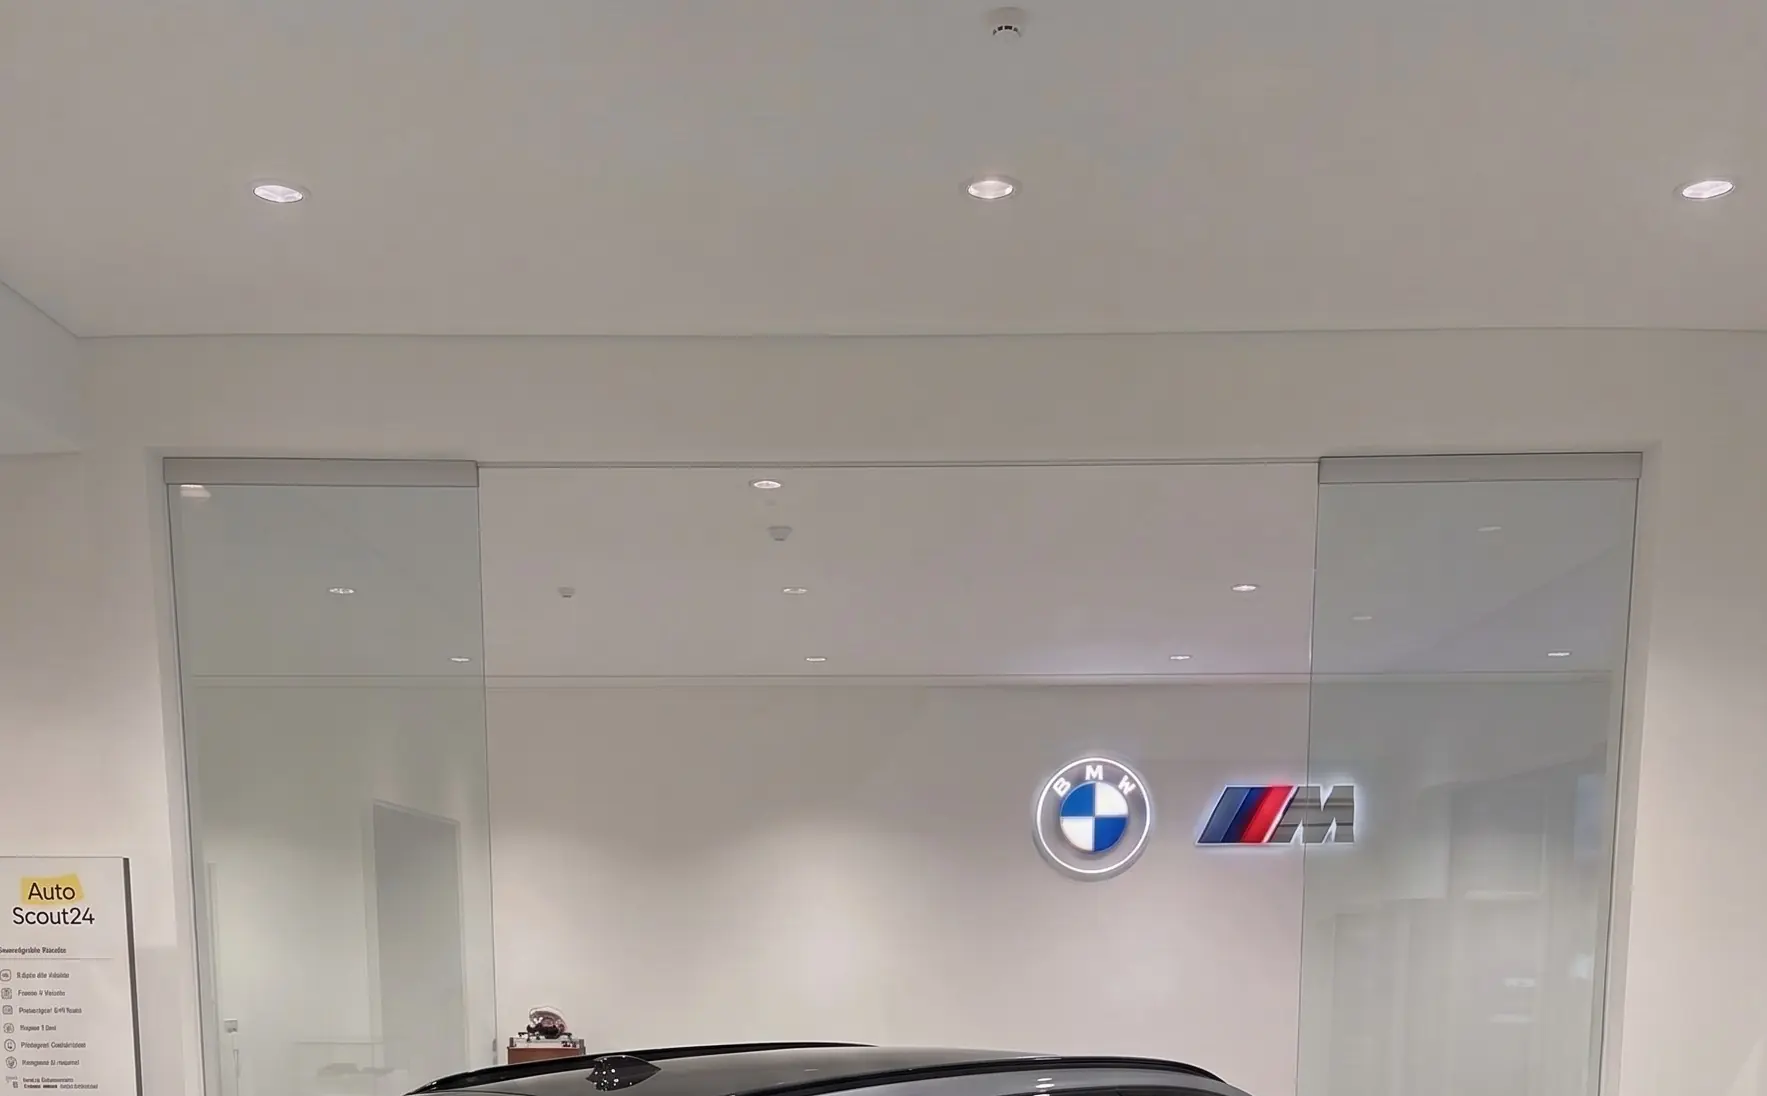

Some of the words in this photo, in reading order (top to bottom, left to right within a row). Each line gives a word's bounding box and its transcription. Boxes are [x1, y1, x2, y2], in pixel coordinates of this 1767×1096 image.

[1052, 764, 1137, 798] BMW
[1262, 784, 1356, 845] M
[27, 881, 76, 901] Auto
[12, 906, 95, 925] Scout24
